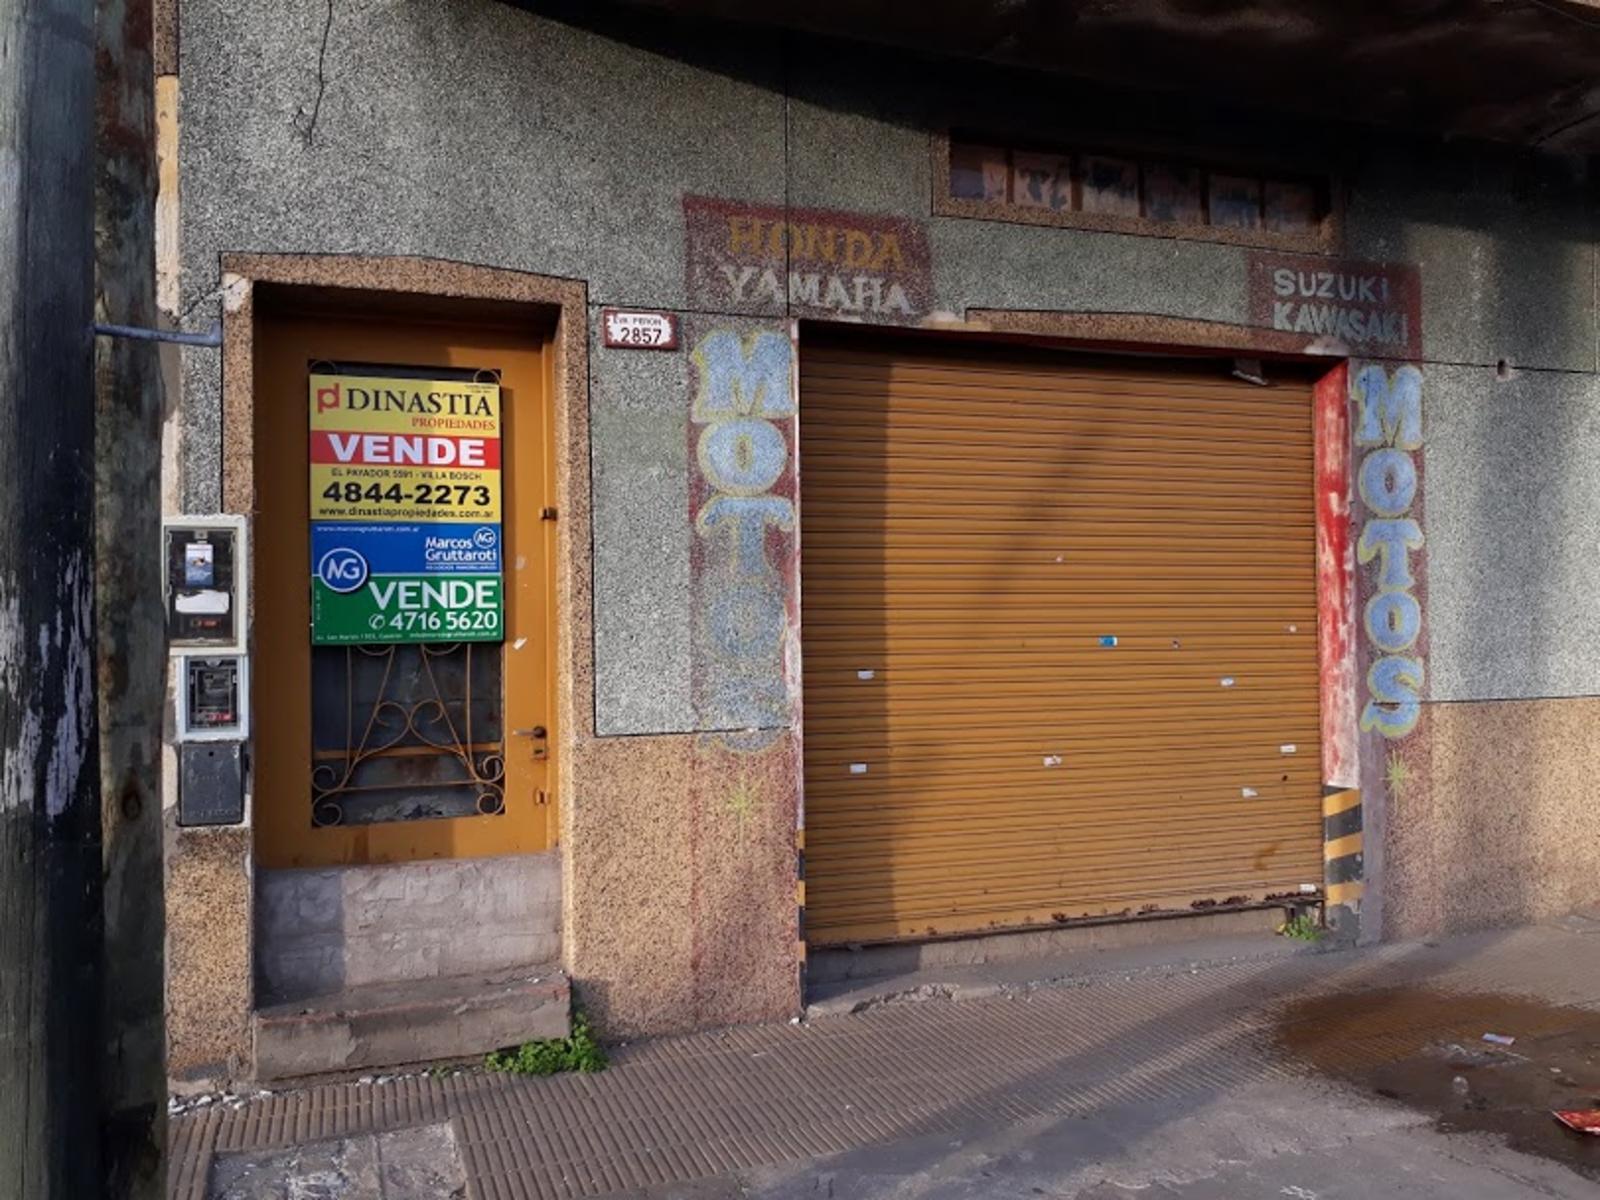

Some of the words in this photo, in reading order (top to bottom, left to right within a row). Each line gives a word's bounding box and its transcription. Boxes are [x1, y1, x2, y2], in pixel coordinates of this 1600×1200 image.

[726, 214, 909, 273] HONDA
[718, 264, 917, 315] YAMAHA
[1273, 268, 1388, 302] SUZUKI
[621, 327, 662, 344] 2857
[1273, 301, 1408, 345] KAWASAKI
[346, 388, 493, 417] DINASTIA
[411, 417, 496, 431] PROPIEDADES
[327, 434, 486, 467] VENDE
[331, 468, 343, 477] EL
[346, 468, 390, 479] PAYADOR
[421, 470, 447, 480] VILLA
[450, 471, 482, 481] BOSCH
[322, 481, 491, 507] 4844-2273
[319, 505, 493, 519] www.dinastiapropiedades.com.ar
[425, 537, 473, 549] Marcos
[425, 548, 497, 562] Gruttaroti
[1351, 363, 1425, 738] MOTOS
[367, 579, 498, 611] VENDE
[389, 611, 442, 631] 4716
[445, 610, 498, 630] 5620
